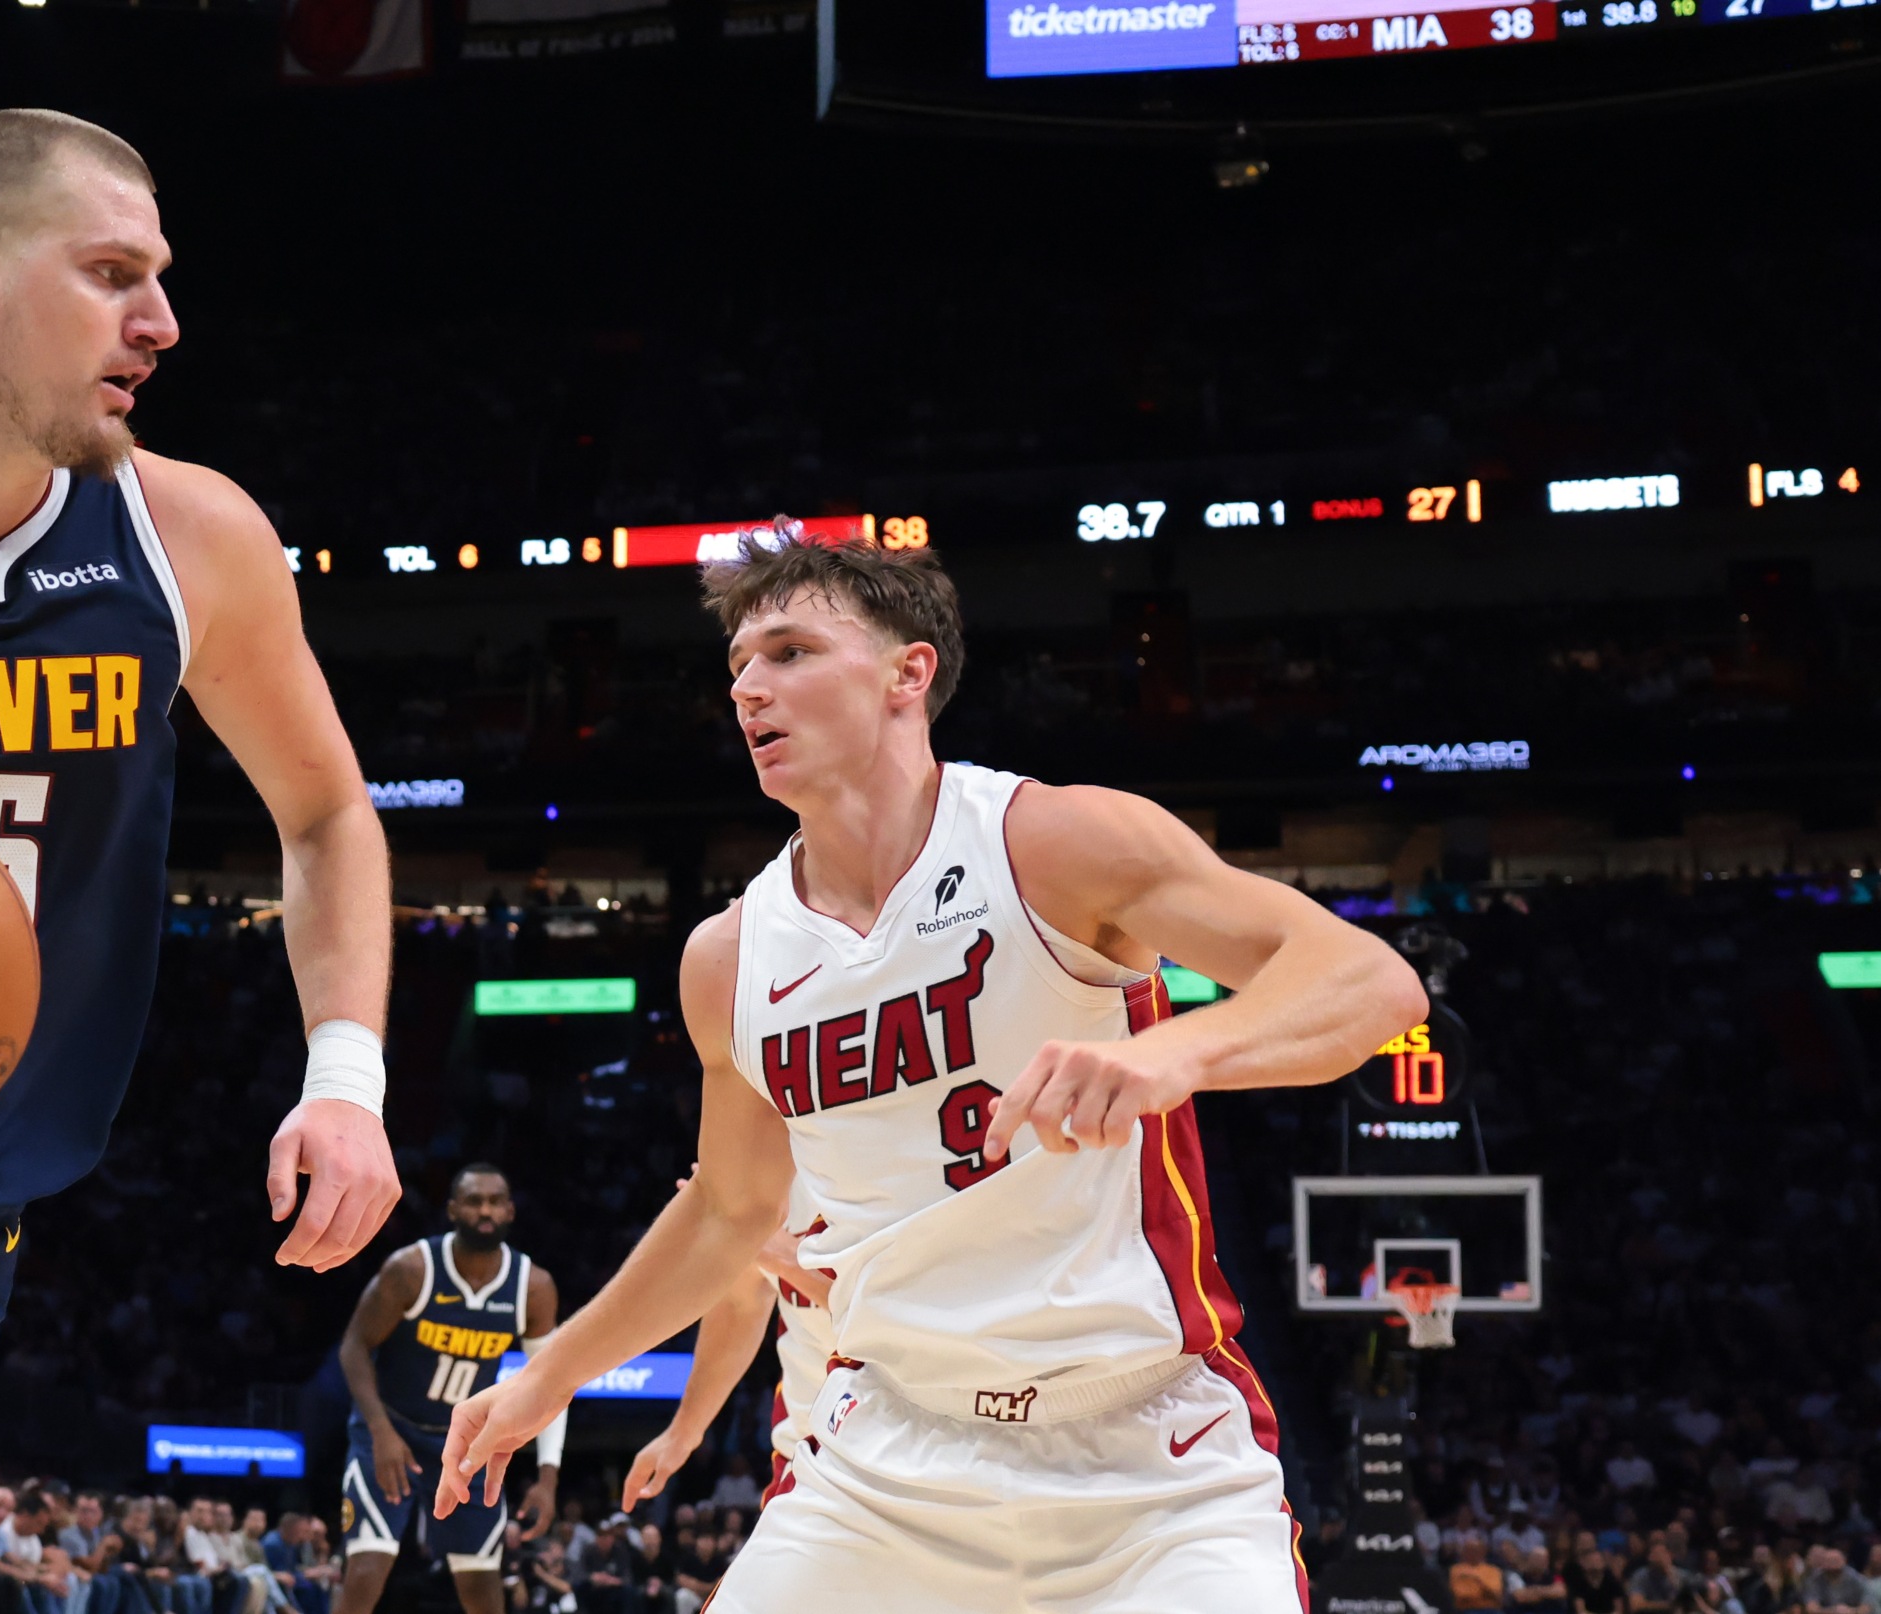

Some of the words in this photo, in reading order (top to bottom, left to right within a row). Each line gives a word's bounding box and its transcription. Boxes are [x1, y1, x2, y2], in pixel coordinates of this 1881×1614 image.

[1009, 3, 1216, 37] ticketmaster
[1372, 14, 1448, 50] MIA
[1490, 7, 1534, 41] 38
[1766, 468, 1824, 497] FLS
[1838, 467, 1860, 493] 4
[1205, 501, 1260, 528] QTR
[1270, 499, 1285, 525] 1
[1407, 486, 1456, 522] 27
[883, 516, 928, 550] 38
[1077, 501, 1166, 542] 38.7
[316, 549, 331, 573] 1
[383, 545, 436, 573] TOL
[458, 543, 478, 569] 6
[521, 537, 570, 566] FLS
[582, 537, 602, 562] 5
[29, 562, 119, 592] ibotta
[1359, 741, 1530, 766] AROMA360
[365, 779, 464, 801] MA360
[916, 900, 990, 936] Robinhood
[761, 928, 995, 1118] HEAT
[1394, 1053, 1443, 1104] 10
[937, 1079, 1012, 1192] 9
[417, 1319, 513, 1359] DENVER
[427, 1353, 479, 1405] 10
